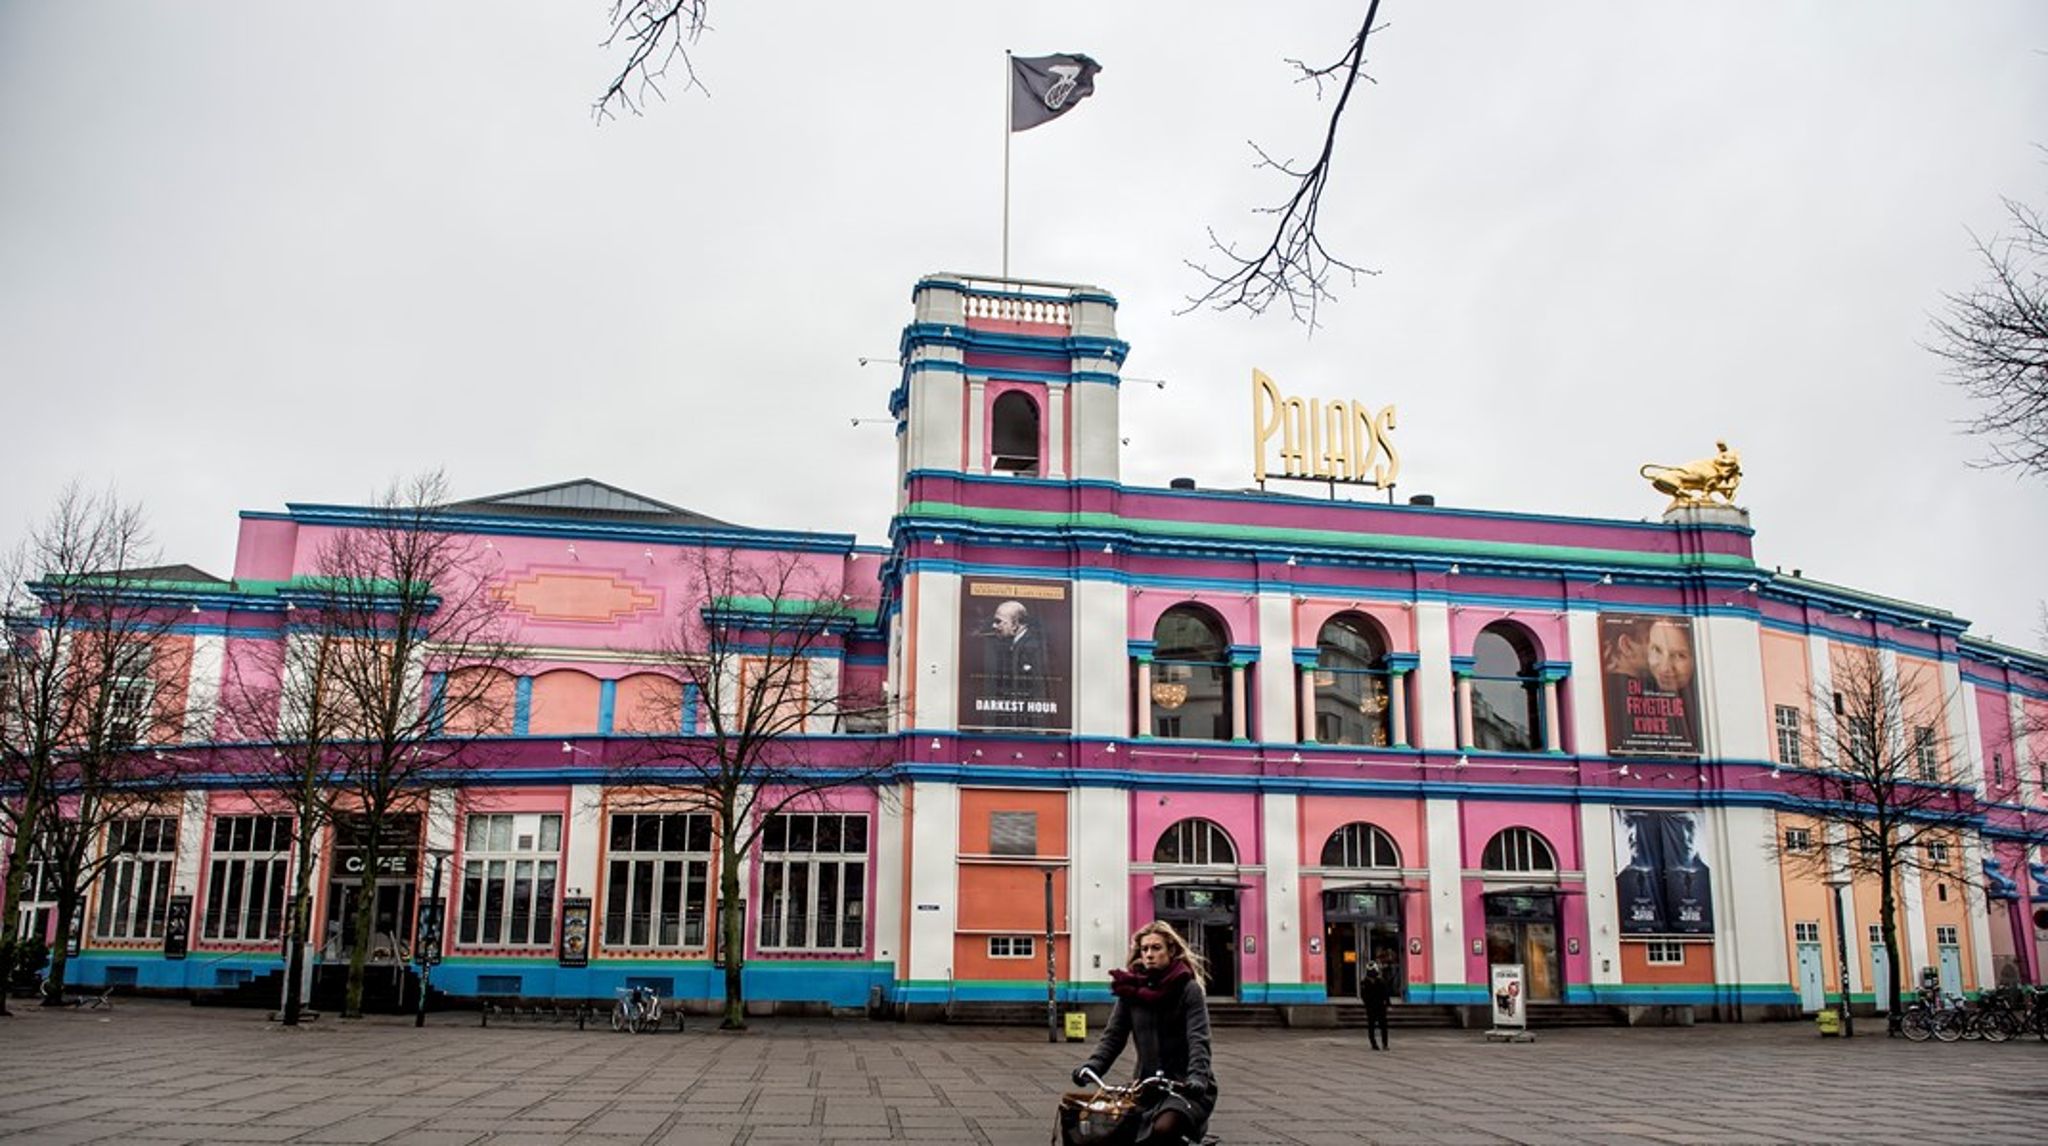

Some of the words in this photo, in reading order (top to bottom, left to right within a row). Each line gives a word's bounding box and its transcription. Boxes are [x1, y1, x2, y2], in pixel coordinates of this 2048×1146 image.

[1253, 367, 1399, 489] PALADS
[1627, 680, 1641, 694] EN
[975, 699, 1024, 712] DARKEST
[1027, 701, 1057, 713] HOUR
